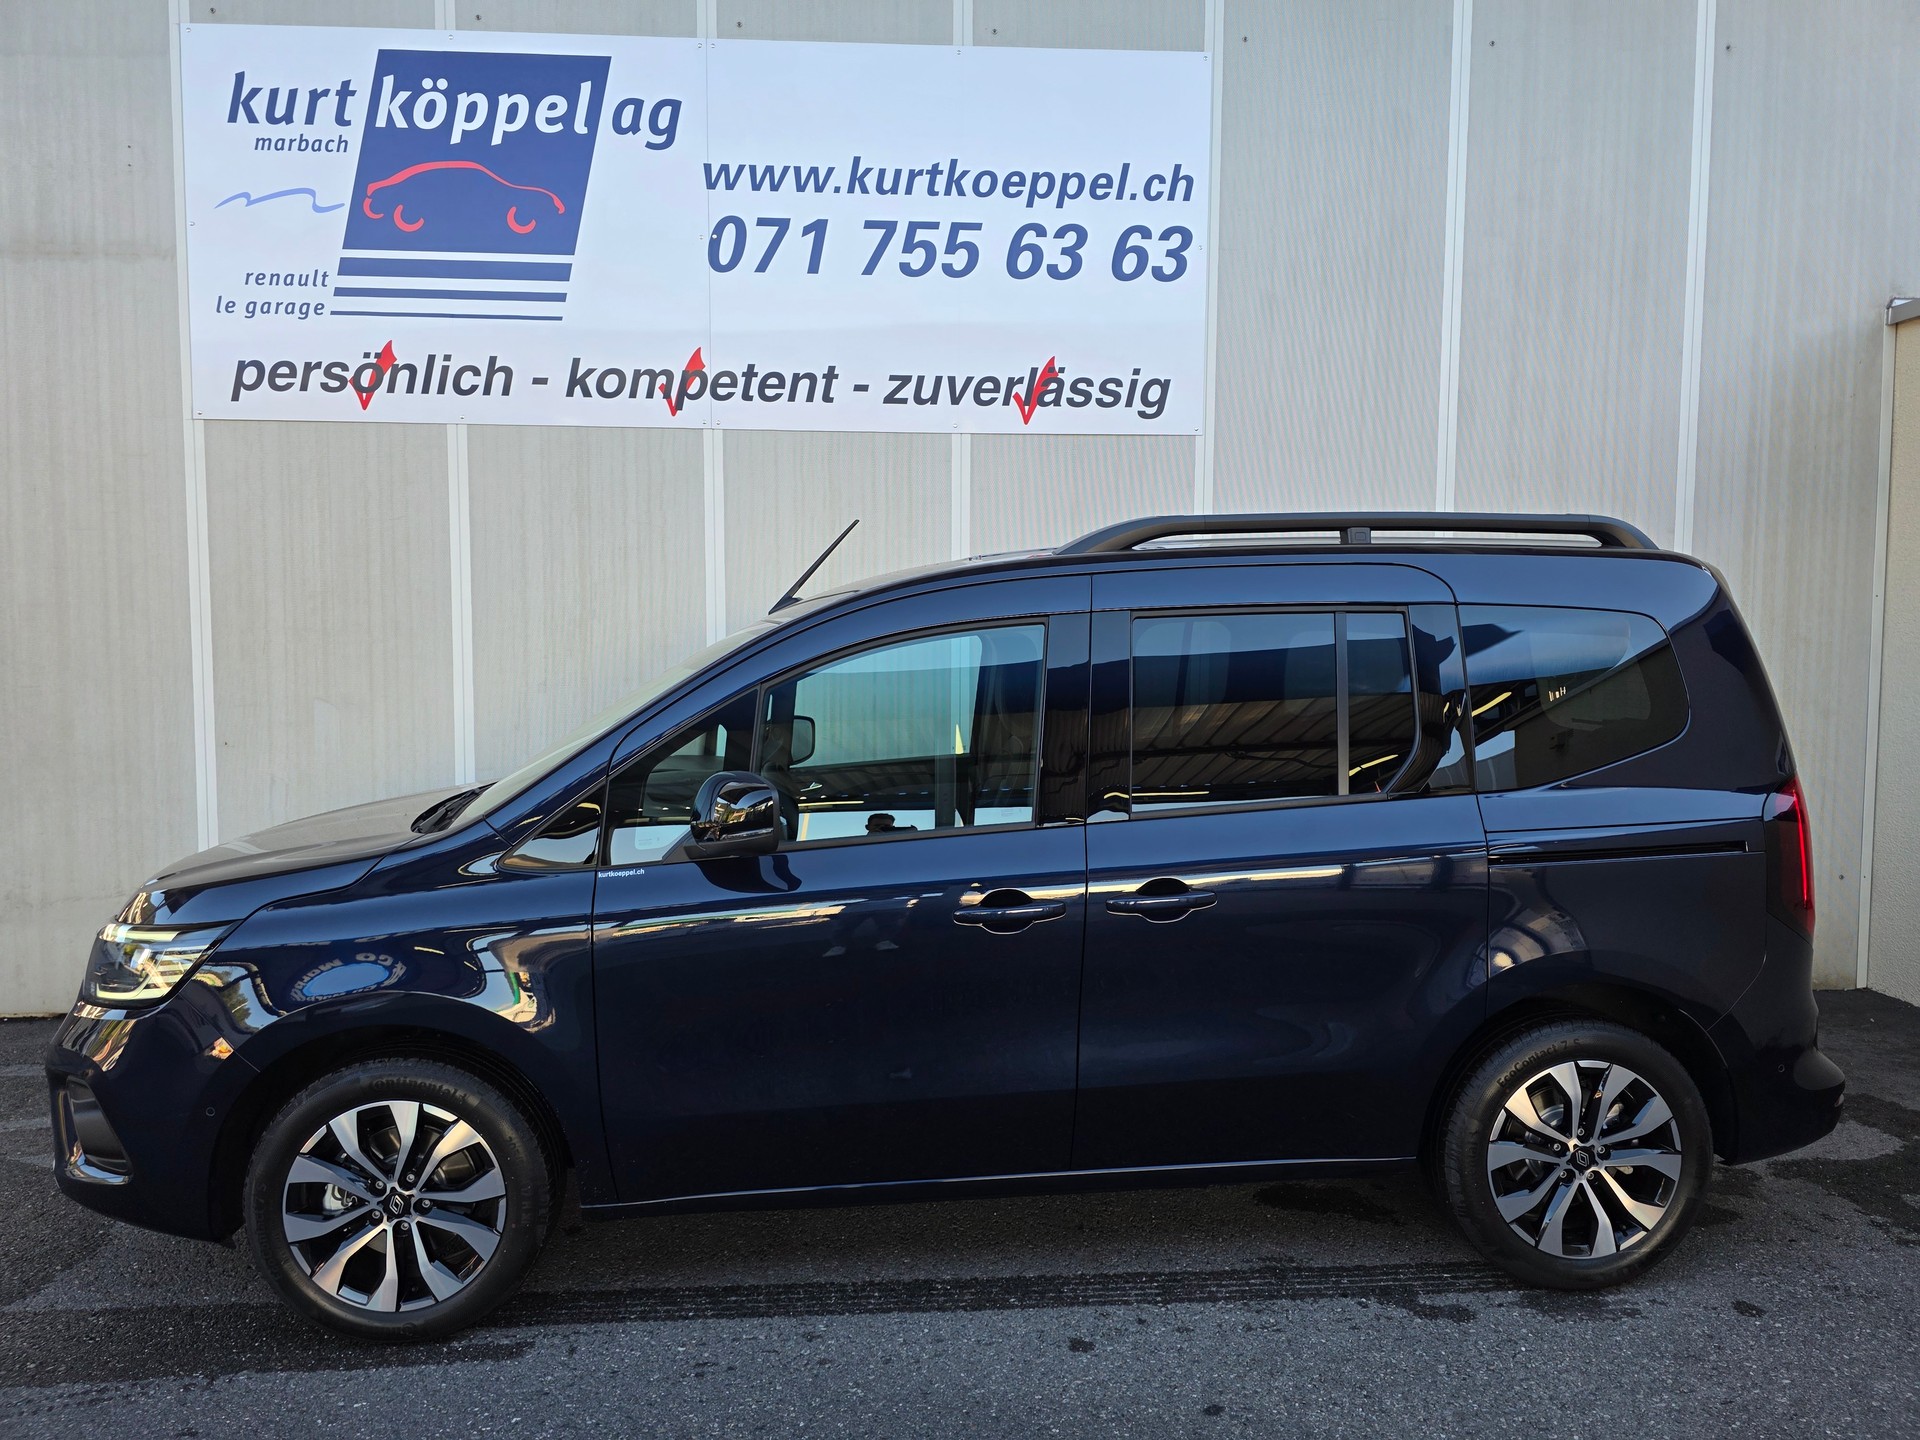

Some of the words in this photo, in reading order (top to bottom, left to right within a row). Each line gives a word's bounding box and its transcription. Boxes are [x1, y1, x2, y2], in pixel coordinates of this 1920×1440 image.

[227, 71, 357, 127] kurt
[375, 75, 591, 146] köppel
[611, 97, 683, 150] ag
[254, 133, 349, 153] marbach
[702, 155, 1195, 209] www.kurtkoeppel.ch
[707, 214, 829, 274] 071
[860, 219, 984, 278] 755
[1005, 222, 1089, 280] 63
[1110, 225, 1194, 282] 63
[244, 268, 329, 288] renault
[215, 296, 238, 315] le
[244, 300, 326, 320] garage
[230, 351, 514, 402] persönlich
[565, 357, 840, 411] kompetent
[882, 366, 1172, 420] zuverlässig
[598, 868, 645, 878] kurtkoeppel.ch
[1496, 1043, 1558, 1088] EcoContact
